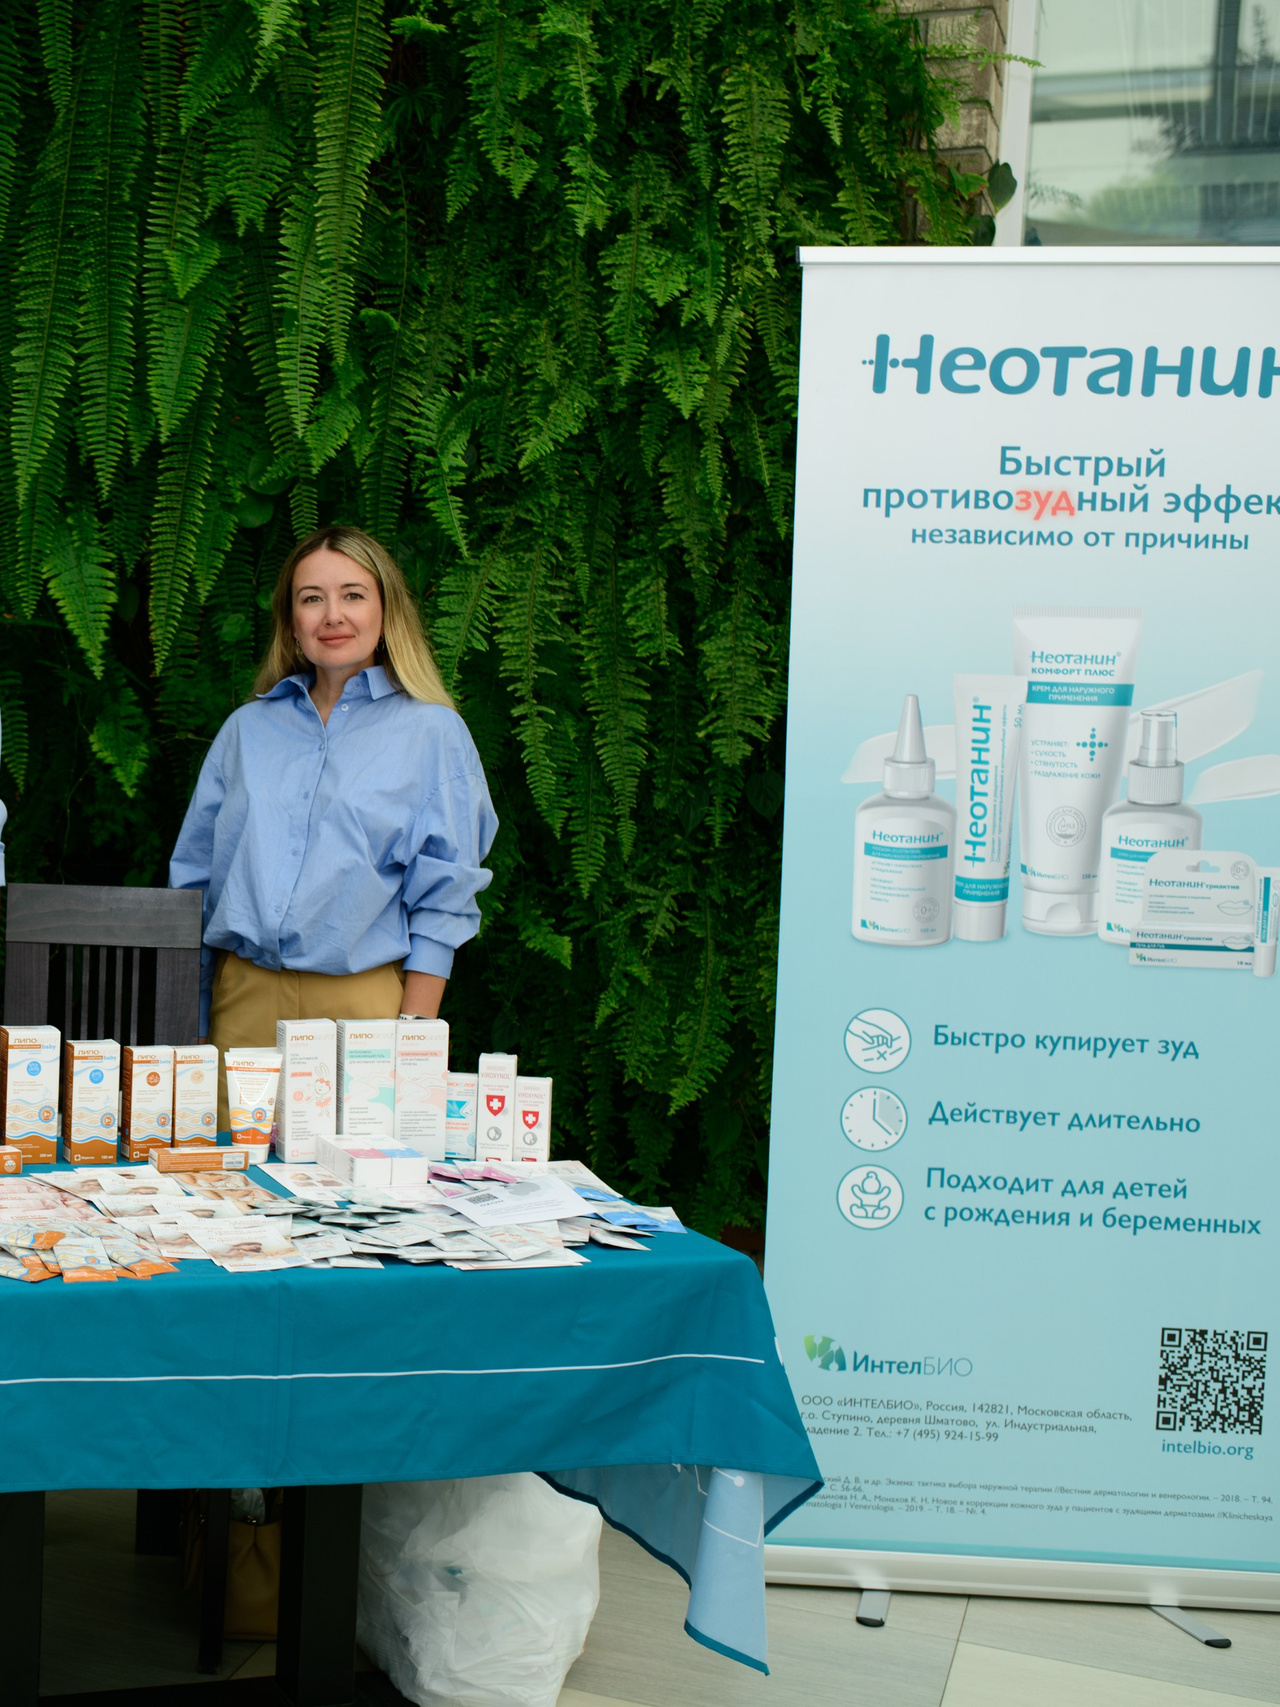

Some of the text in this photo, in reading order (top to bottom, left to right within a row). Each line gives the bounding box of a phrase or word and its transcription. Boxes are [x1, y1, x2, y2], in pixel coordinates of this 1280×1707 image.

[999, 446, 1166, 486] Быстрый
[862, 484, 1280, 523] противозудный эффек
[911, 527, 1249, 555] независимо от причины
[1031, 667, 1115, 677] КОМФОРТ ПЛЮС
[1032, 685, 1115, 695] КРЕМ ДЛЯ НАРУЖНОГО
[933, 1024, 1200, 1061] Быстро купирует зуд
[928, 1100, 1201, 1133] Действует длительно
[926, 1167, 1188, 1200] Подходит для детей
[924, 1206, 1261, 1236] с рождения и беременных
[852, 1349, 973, 1377] ИнтелБИО
[801, 1394, 1132, 1422] ООО «ИНТЕЛБИО», Россия, 142821, Московская область,
[801, 1410, 1097, 1434] г.о. Ступино, деревня Шматово, ул. Индустриальная,
[805, 1426, 999, 1442] ладение 2. Тел.: +7 (495) 924-15-99
[1161, 1438, 1255, 1460] intelbio.org
